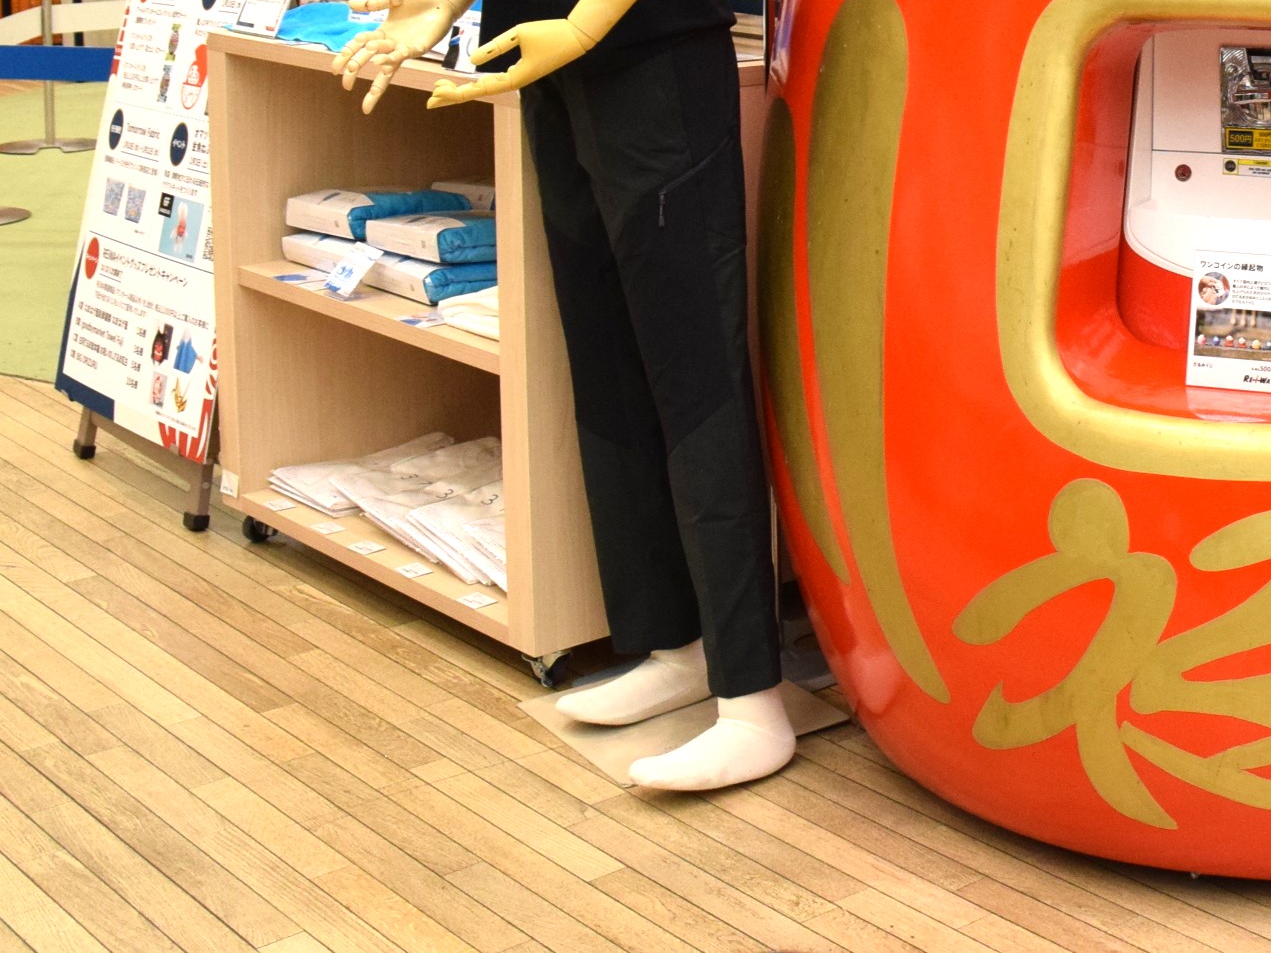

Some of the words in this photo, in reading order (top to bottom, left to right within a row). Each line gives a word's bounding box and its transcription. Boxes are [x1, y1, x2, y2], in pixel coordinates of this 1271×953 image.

[1230, 134, 1252, 143] 500円
[1200, 260, 1264, 273] ワンコインの縁起物
